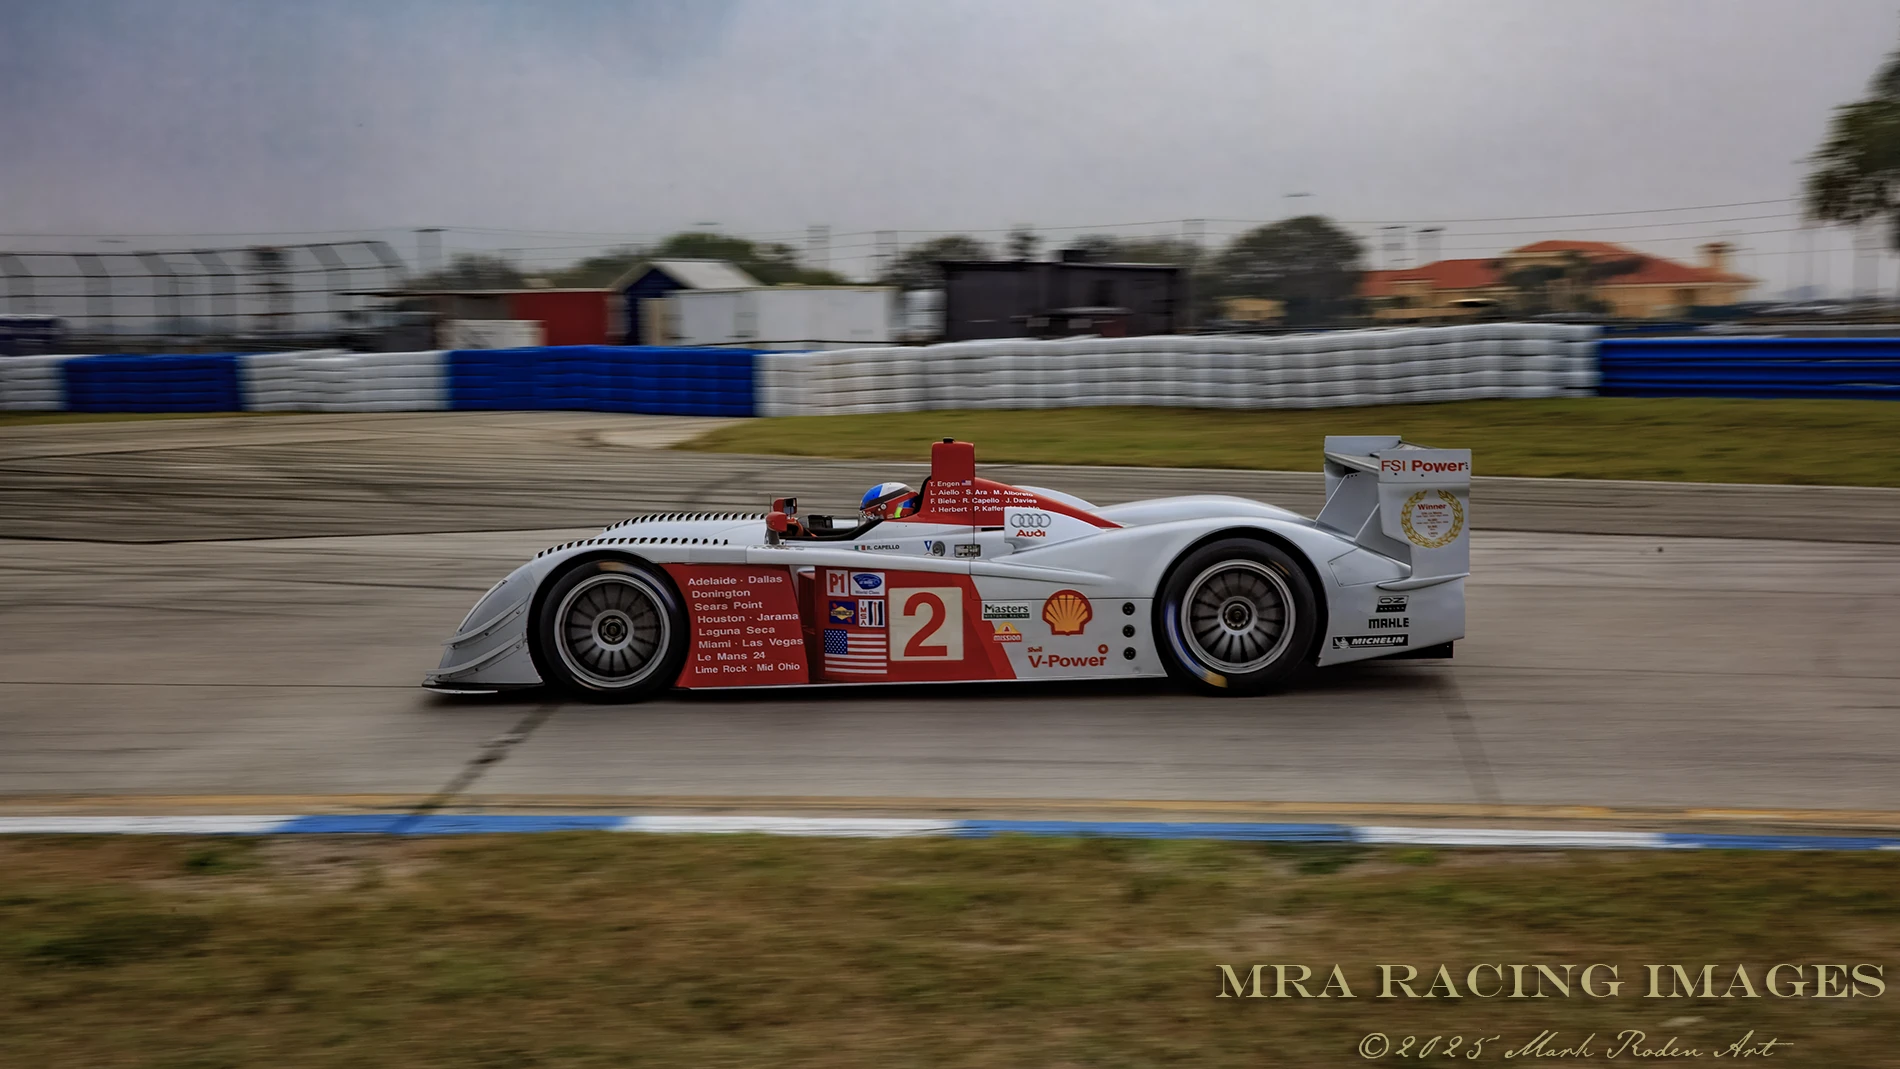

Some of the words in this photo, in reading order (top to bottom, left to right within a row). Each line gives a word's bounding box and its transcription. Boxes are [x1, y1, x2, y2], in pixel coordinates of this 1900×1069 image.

[1381, 460, 1406, 472] FSI
[1412, 460, 1465, 472] Power
[971, 497, 1000, 505] Capello
[1016, 529, 1046, 537] Audi
[688, 577, 737, 586] Adelaide
[748, 575, 783, 584] Dallas
[829, 573, 845, 593] P1
[692, 589, 751, 599] Donington
[694, 602, 728, 611] Sears
[734, 601, 763, 609] Point
[984, 604, 1029, 613] Masters
[697, 615, 745, 623] Houston
[757, 613, 799, 622] Jarama
[1368, 618, 1409, 629] MAHLE
[903, 591, 948, 657] 2
[699, 628, 740, 637] Laguna
[746, 626, 775, 634] Seca
[699, 640, 731, 649] Miami
[742, 639, 763, 647] Las
[769, 638, 804, 647] Vegas
[1351, 637, 1405, 645] MICHELIN
[697, 653, 711, 661] Le
[717, 652, 747, 660] Mans
[753, 651, 765, 659] 24
[1028, 655, 1107, 668] V-Power
[695, 666, 718, 674] Lime
[723, 665, 747, 673] Rock
[757, 663, 774, 671] Mid
[778, 663, 800, 671] Ohio
